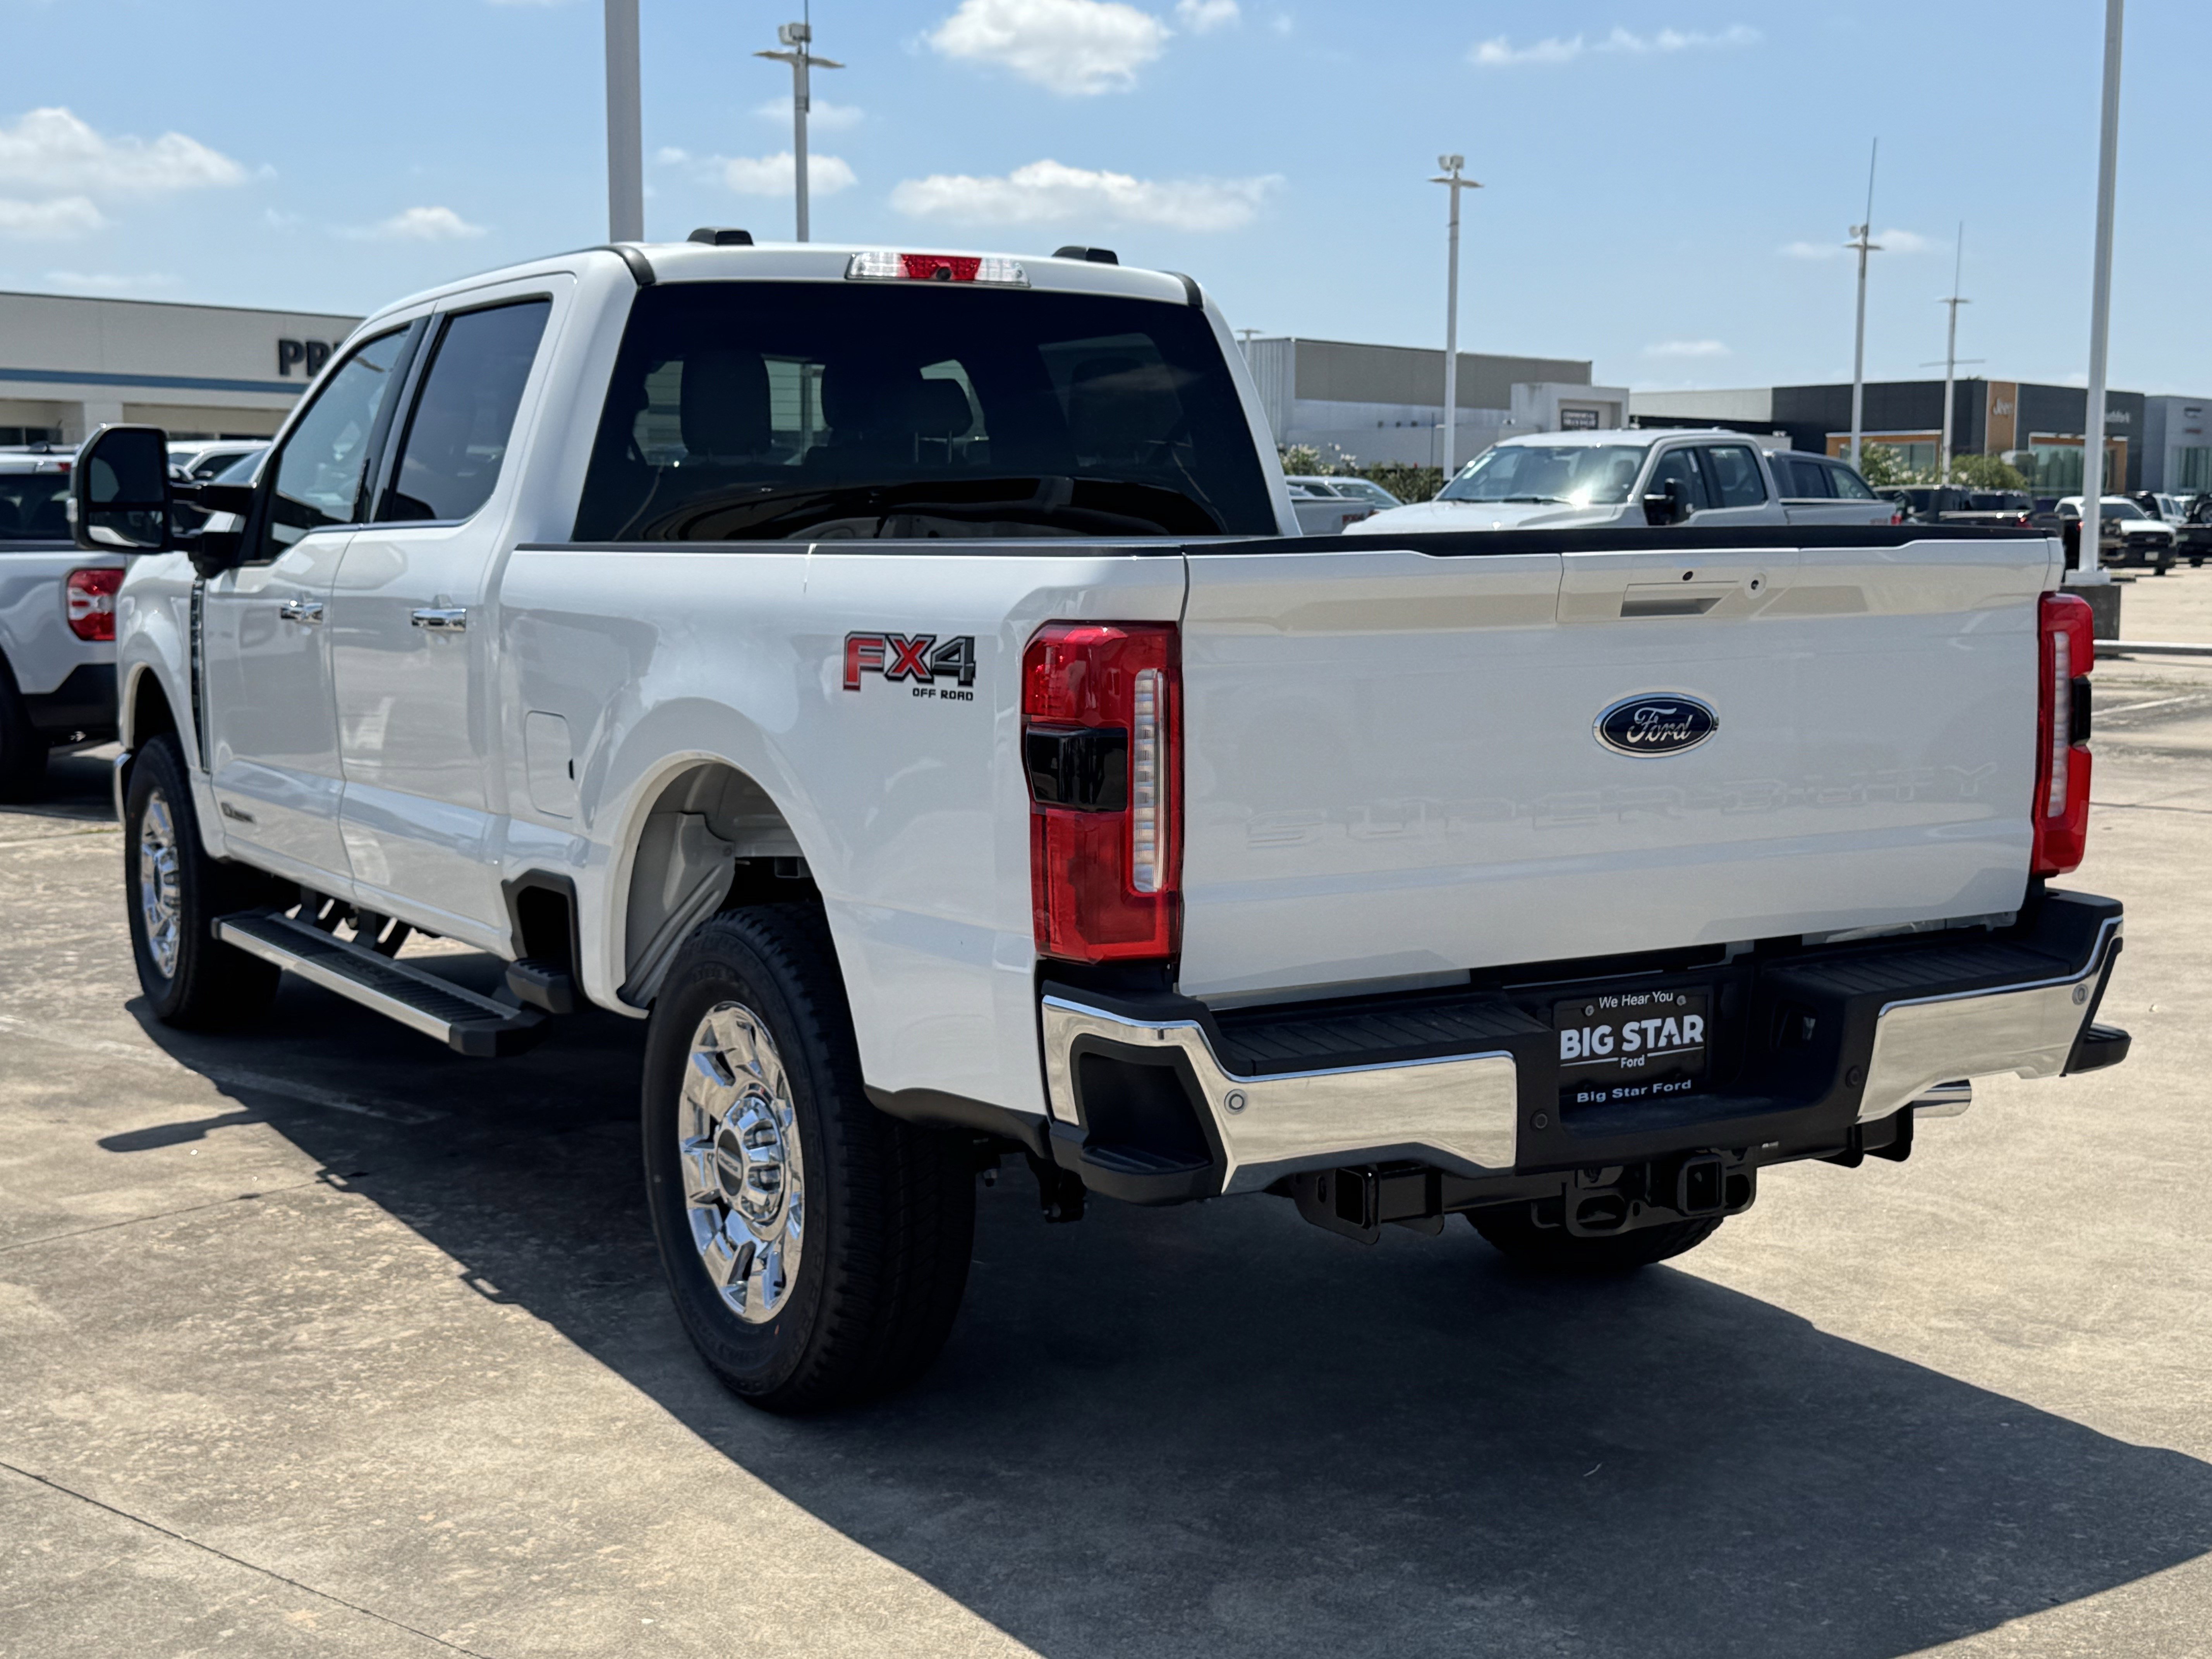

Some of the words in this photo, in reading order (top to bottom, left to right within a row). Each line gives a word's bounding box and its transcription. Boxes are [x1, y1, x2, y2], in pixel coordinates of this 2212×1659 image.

[843, 631, 976, 691] FX4
[912, 687, 936, 698] OFF
[941, 690, 973, 701] ROAD
[1627, 707, 1693, 743] Ford
[1246, 783, 1685, 850] SUPER
[1719, 761, 1998, 816] DUTY
[1599, 996, 1618, 1009] We
[1621, 994, 1650, 1007] Hear
[1652, 991, 1673, 1003] You
[1560, 1025, 1614, 1060] BIG
[1622, 1014, 1704, 1051] STAR
[1621, 1054, 1645, 1068] Ford
[1577, 1091, 1606, 1103] Big
[1612, 1085, 1648, 1099] Star
[1653, 1080, 1692, 1093] Ford
